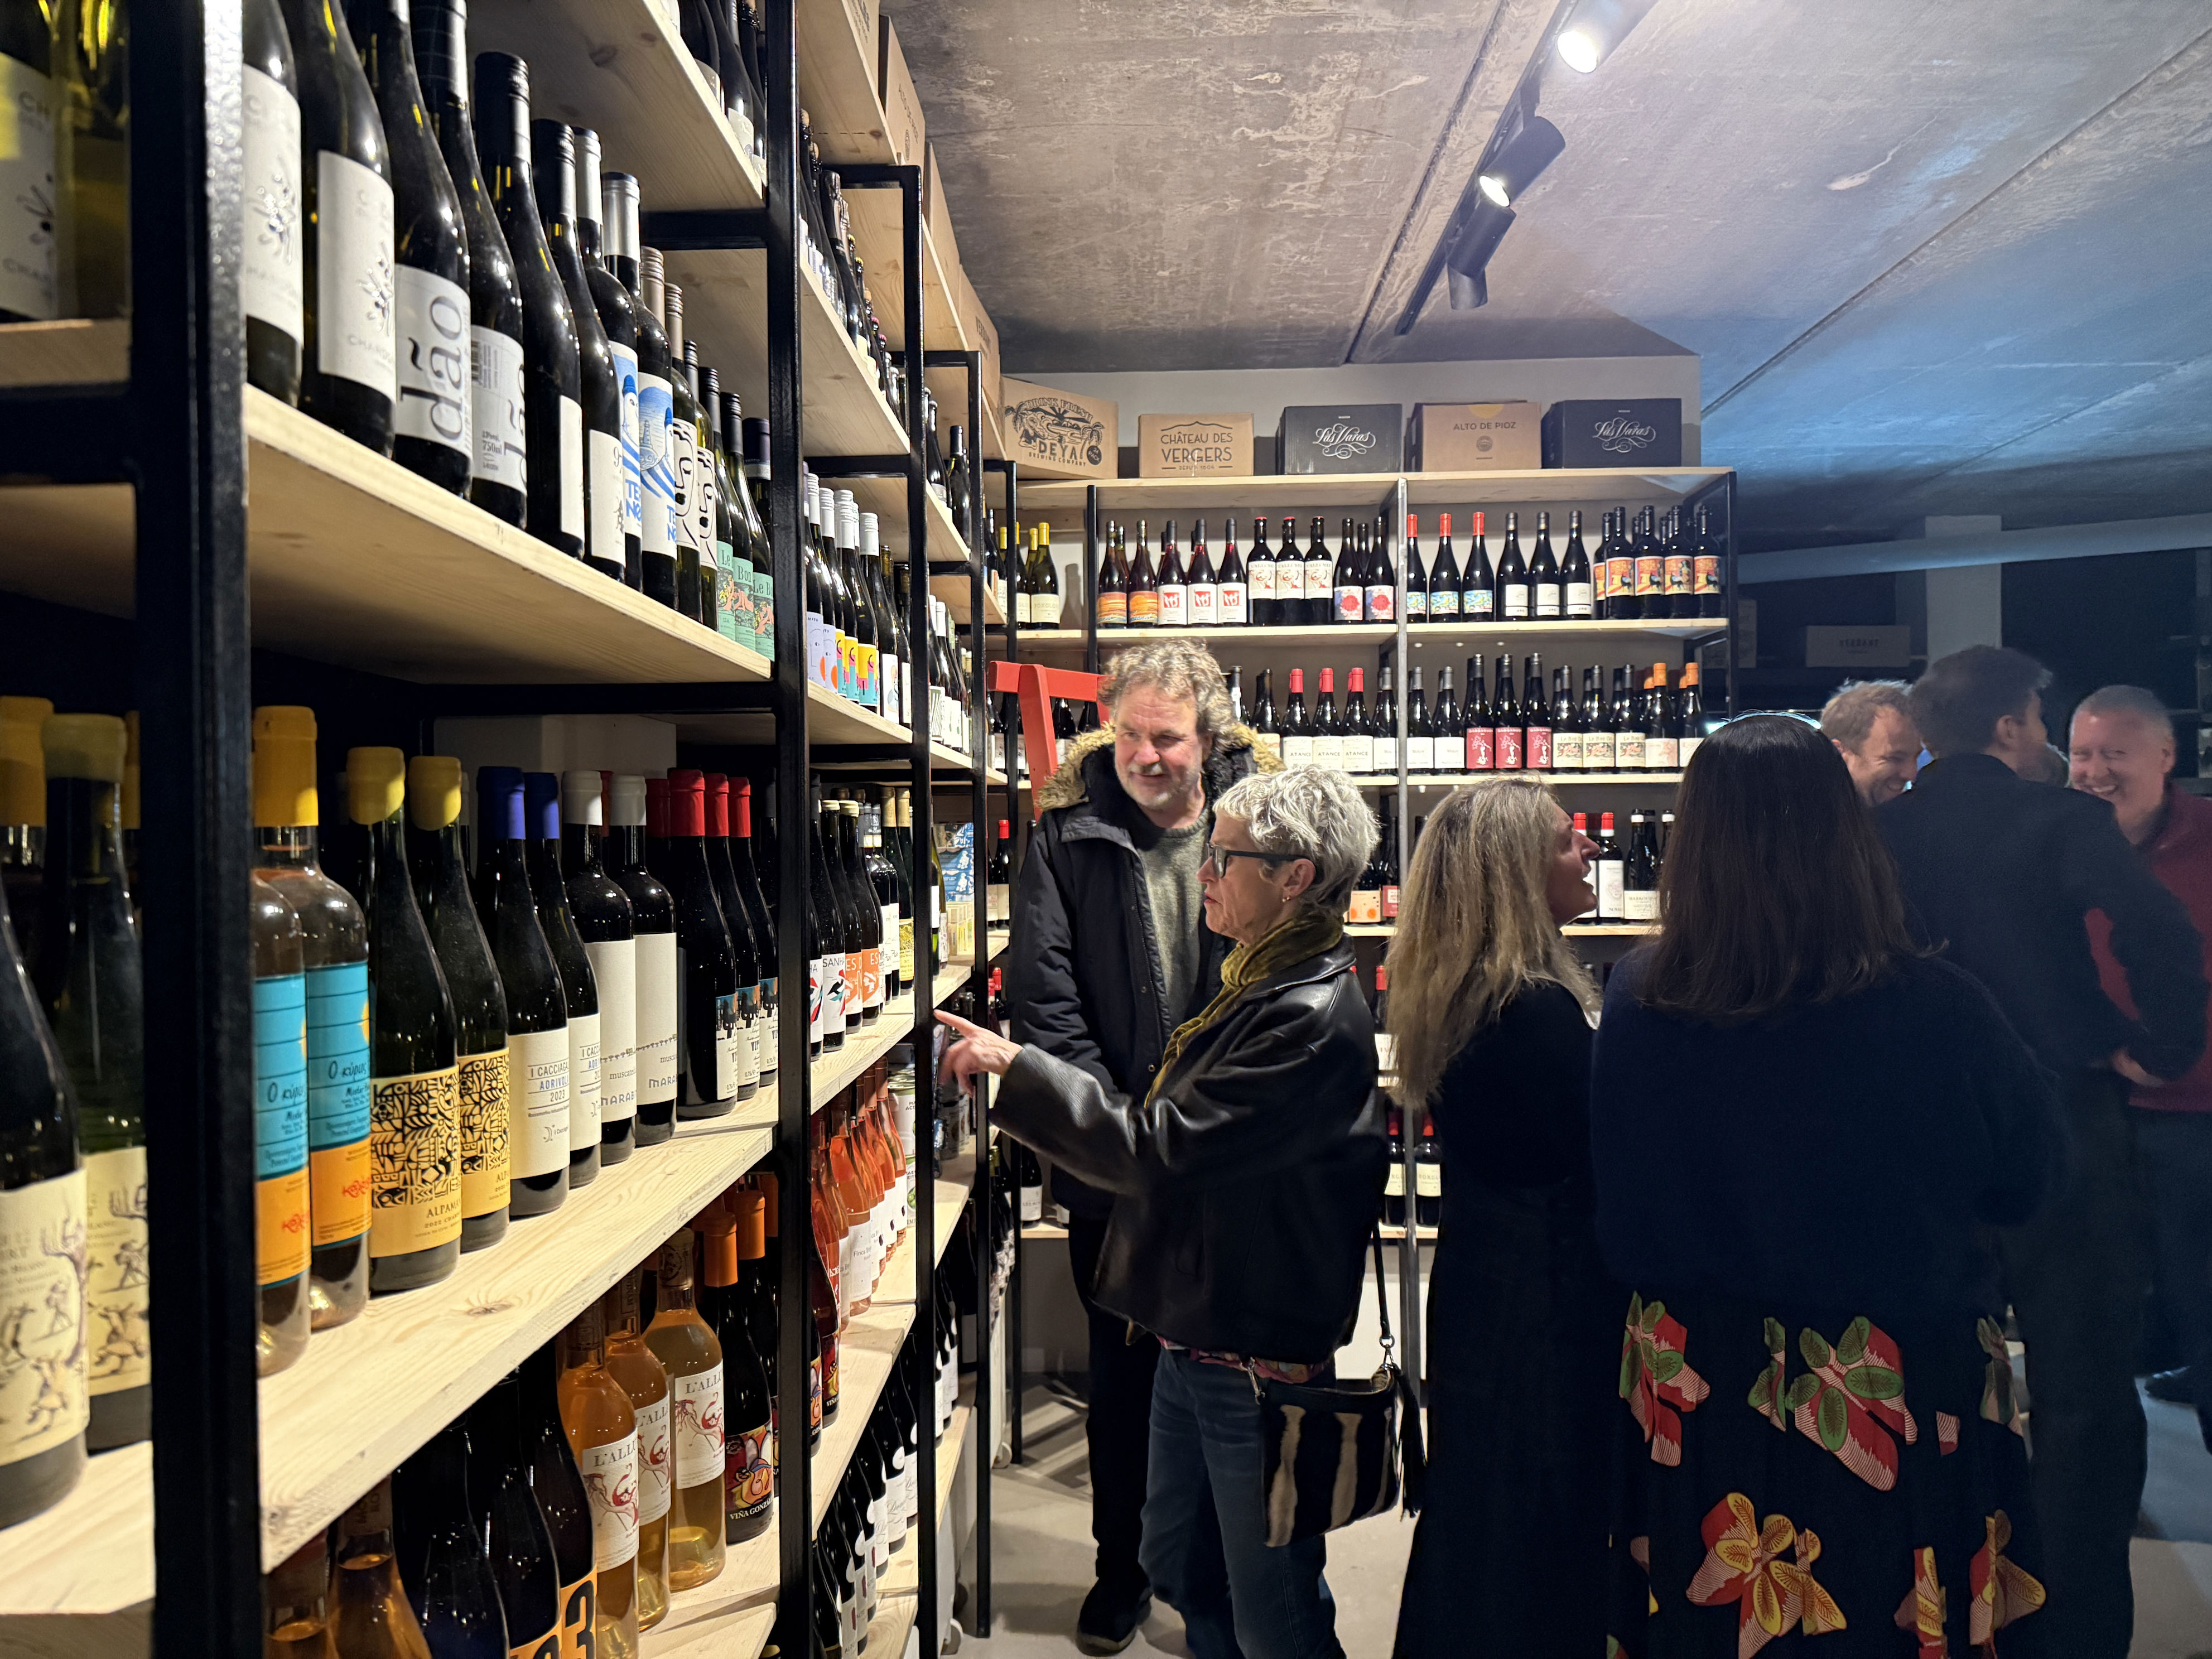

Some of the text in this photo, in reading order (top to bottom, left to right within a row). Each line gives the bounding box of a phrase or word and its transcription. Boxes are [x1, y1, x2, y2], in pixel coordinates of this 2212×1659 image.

[400, 296, 463, 441] dão
[1025, 397, 1093, 422] DRINK FRESH
[1453, 422, 1477, 431] ALTO
[1593, 417, 1656, 442] Las Varas
[1161, 431, 1233, 445] CHÂTEAU DES
[1313, 423, 1376, 448] Las Varas
[483, 440, 502, 455] 750ml
[1039, 440, 1078, 460] DEYA
[1162, 447, 1232, 463] VERGERS
[1029, 452, 1086, 467] BREWING COMPANY
[722, 550, 730, 567] Le
[738, 565, 751, 582] Bon
[753, 580, 764, 594] Le
[550, 1089, 565, 1102] 2023
[853, 1247, 866, 1257] Finca
[730, 1510, 749, 1520] VIÑA
